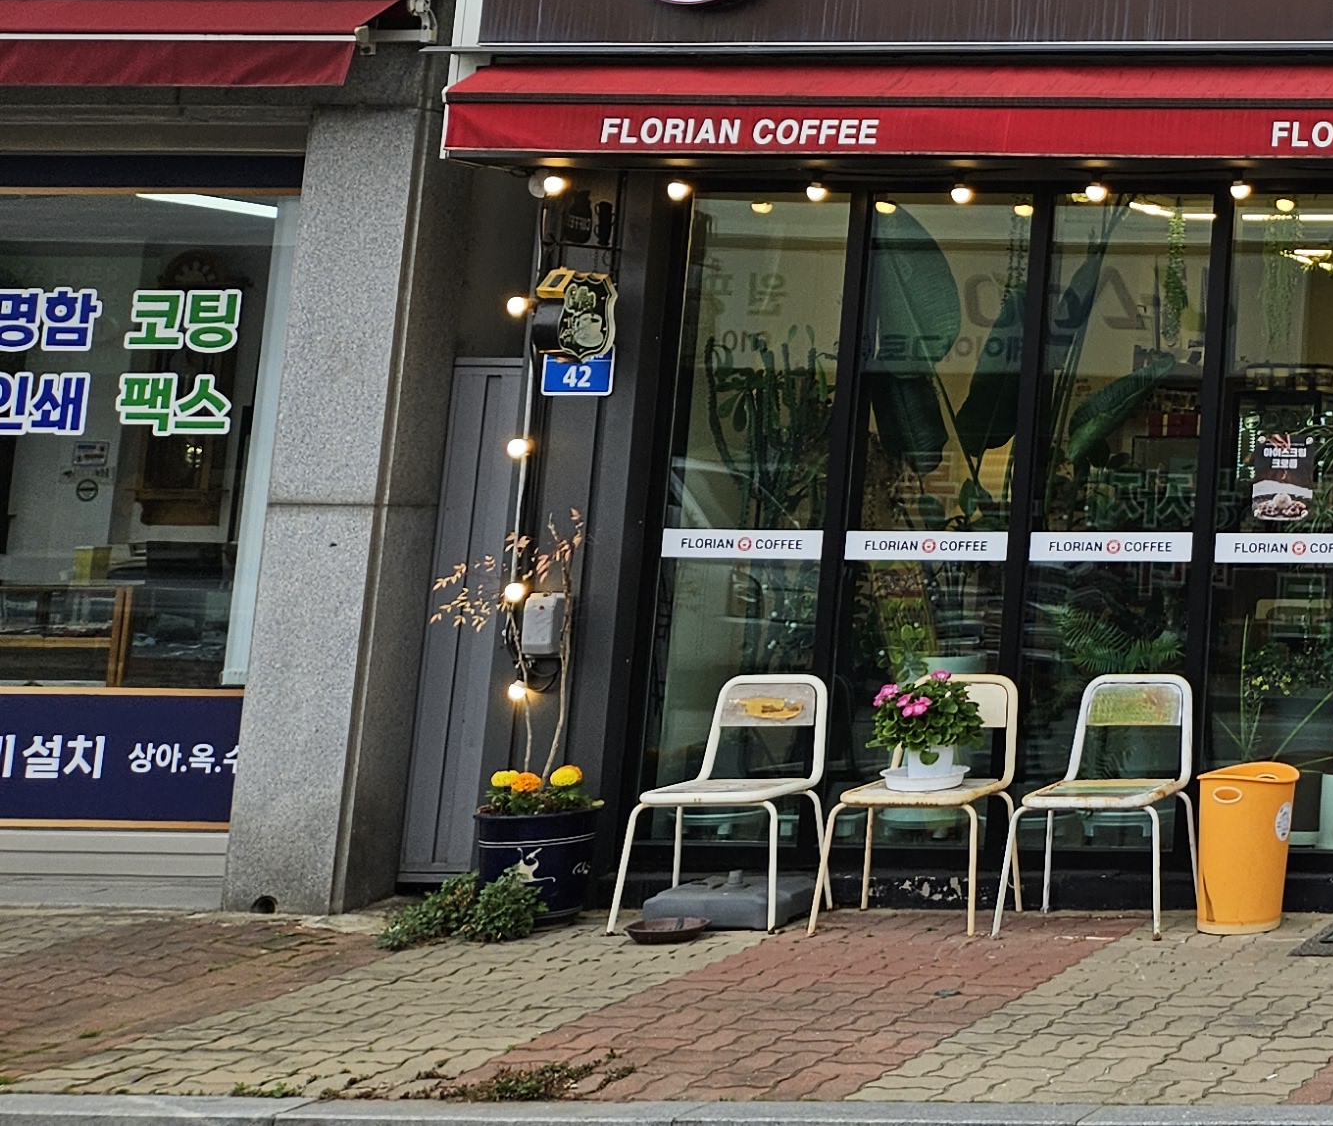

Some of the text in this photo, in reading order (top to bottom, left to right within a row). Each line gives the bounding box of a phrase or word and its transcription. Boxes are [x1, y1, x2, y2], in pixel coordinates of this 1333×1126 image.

[600, 117, 880, 146] FLORIAN COFFEE
[0, 289, 241, 352] 명함 코팅
[562, 365, 592, 388] 42
[0, 374, 230, 434] 인쇄 팩스
[681, 537, 803, 550] FLORIAN COFFEE
[864, 540, 988, 552] FLORIAN COFFEE
[1048, 541, 1172, 553] FLORIAN COFFEE
[1234, 542, 1288, 554] FLORIAN
